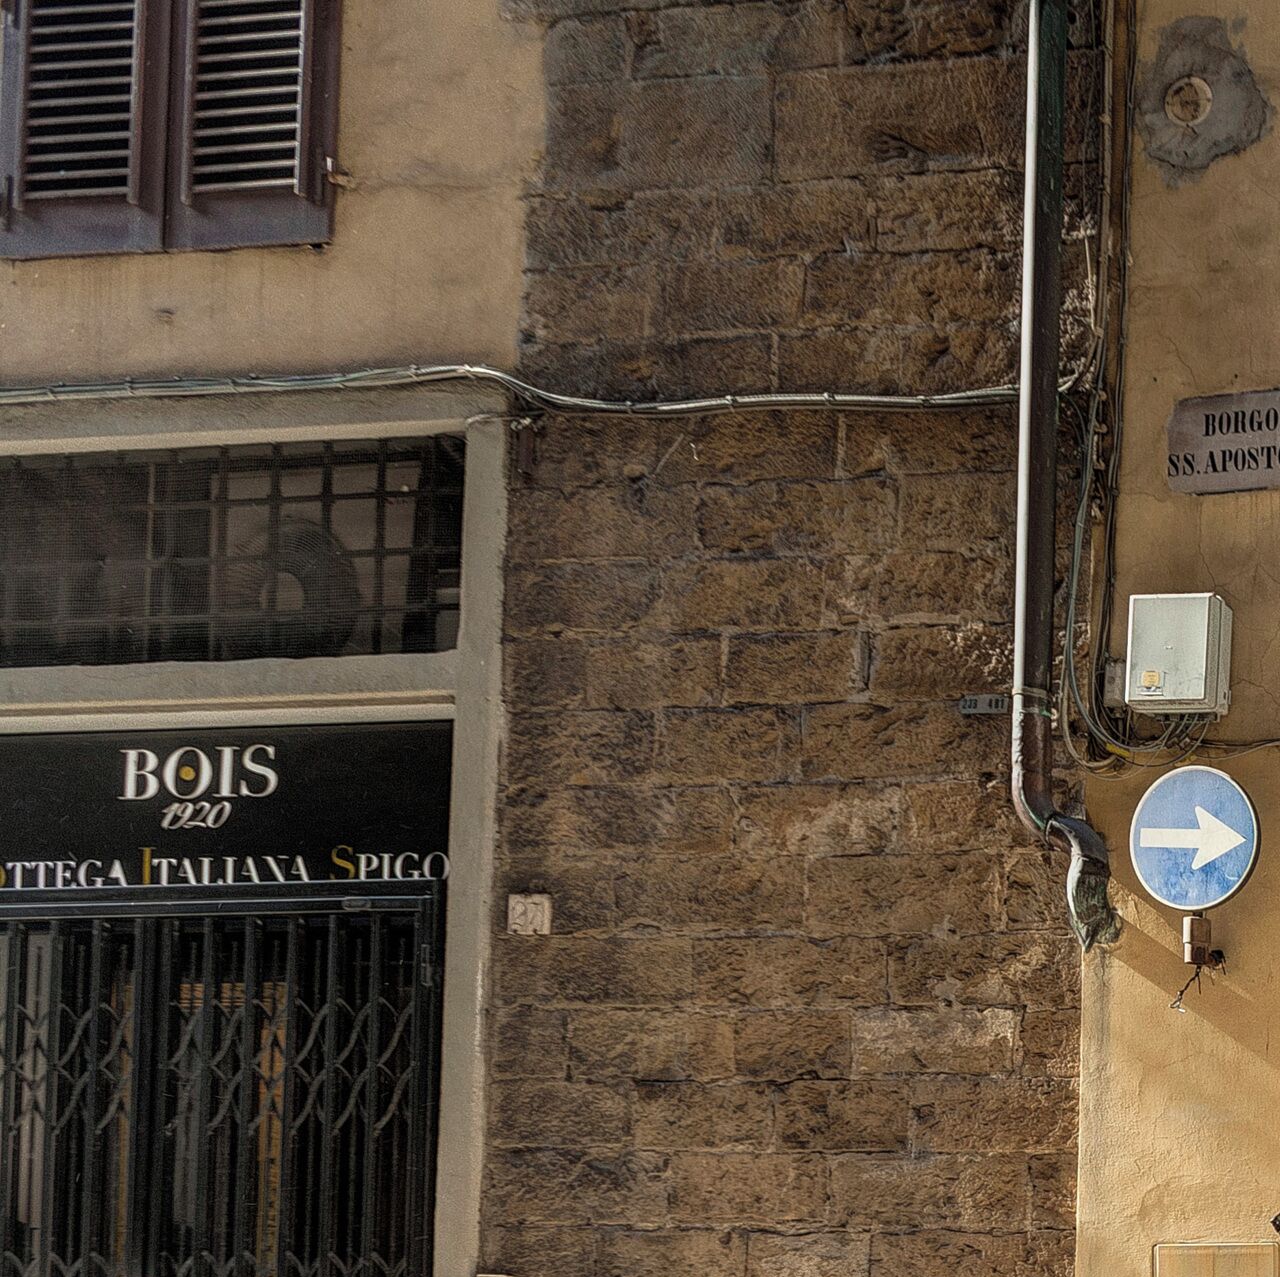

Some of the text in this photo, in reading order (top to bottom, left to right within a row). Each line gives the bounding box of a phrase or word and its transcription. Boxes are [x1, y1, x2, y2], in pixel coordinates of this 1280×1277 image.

[1203, 408, 1279, 437] BORGO
[117, 744, 279, 800] BOIS
[161, 801, 232, 830] 1920
[138, 847, 310, 886] ITALIANA
[330, 845, 450, 881] SPIGO
